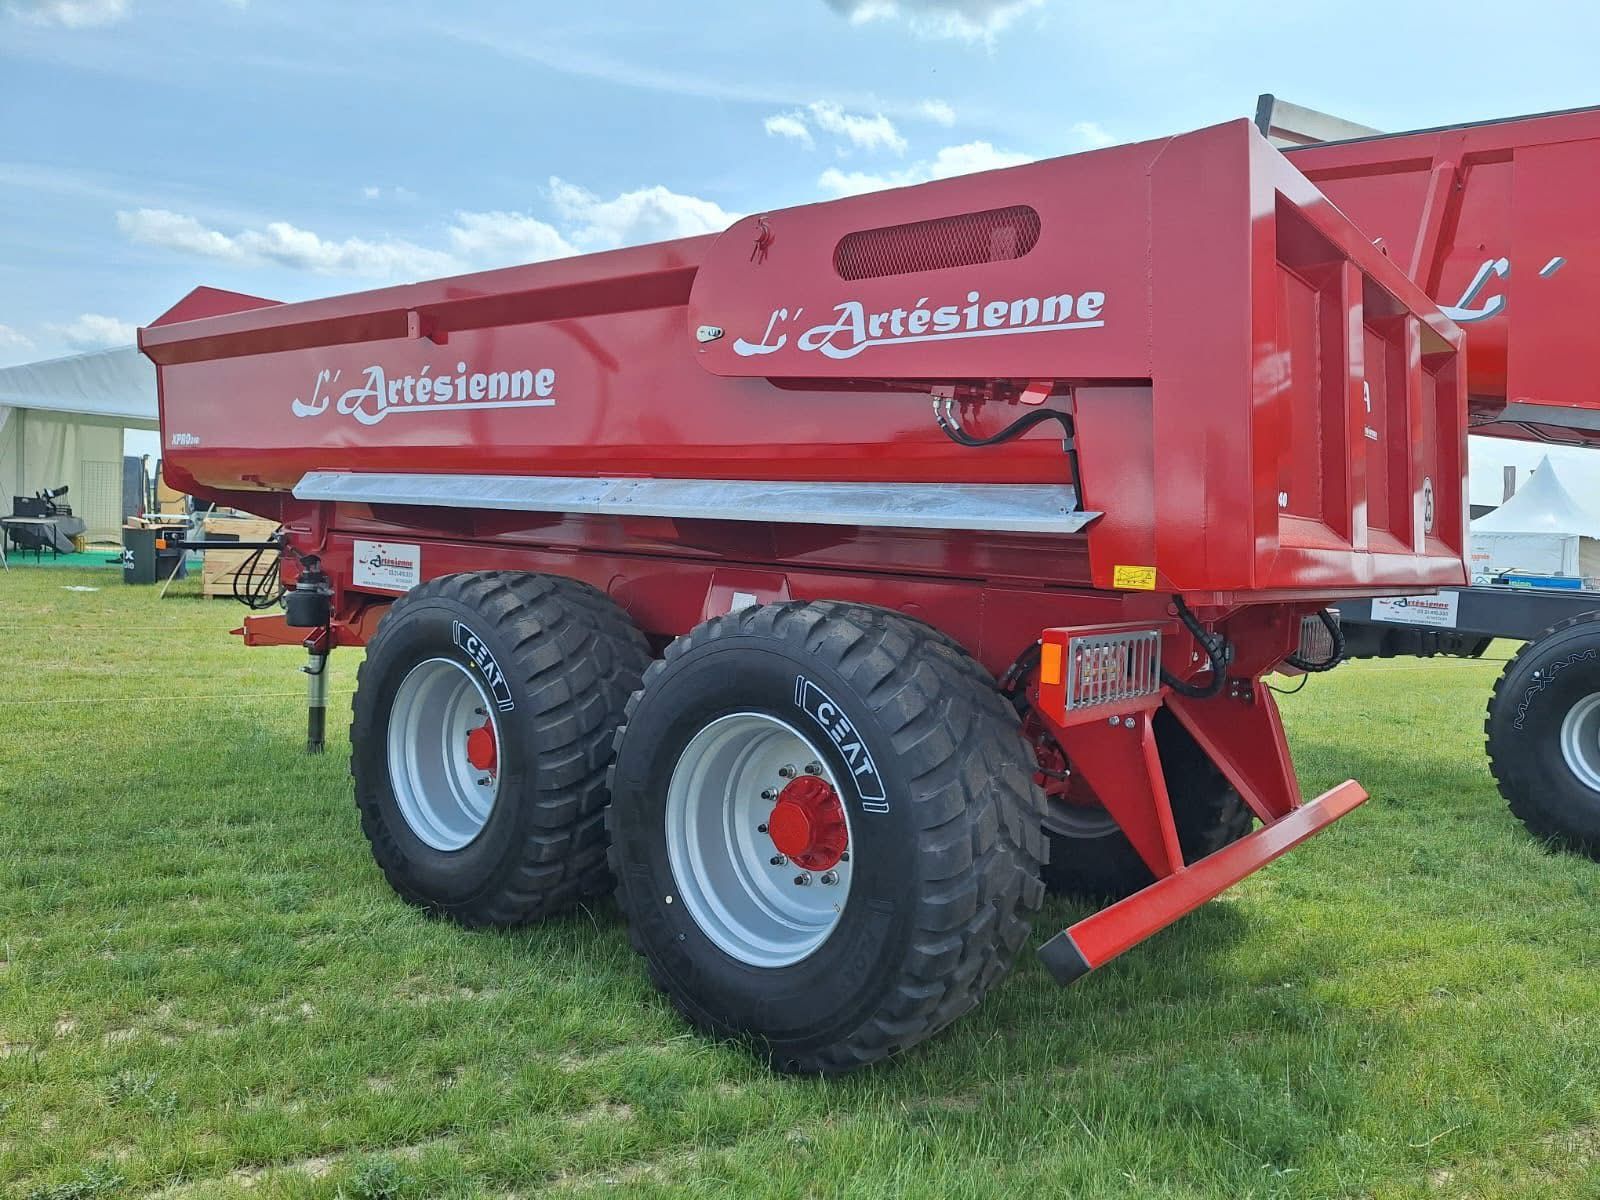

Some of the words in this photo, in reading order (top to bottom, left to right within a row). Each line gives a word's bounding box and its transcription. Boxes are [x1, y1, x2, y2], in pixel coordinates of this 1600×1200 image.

[466, 637, 504, 689] CEAT
[1513, 649, 1597, 730] MAXAM
[817, 702, 874, 778] CEAT
